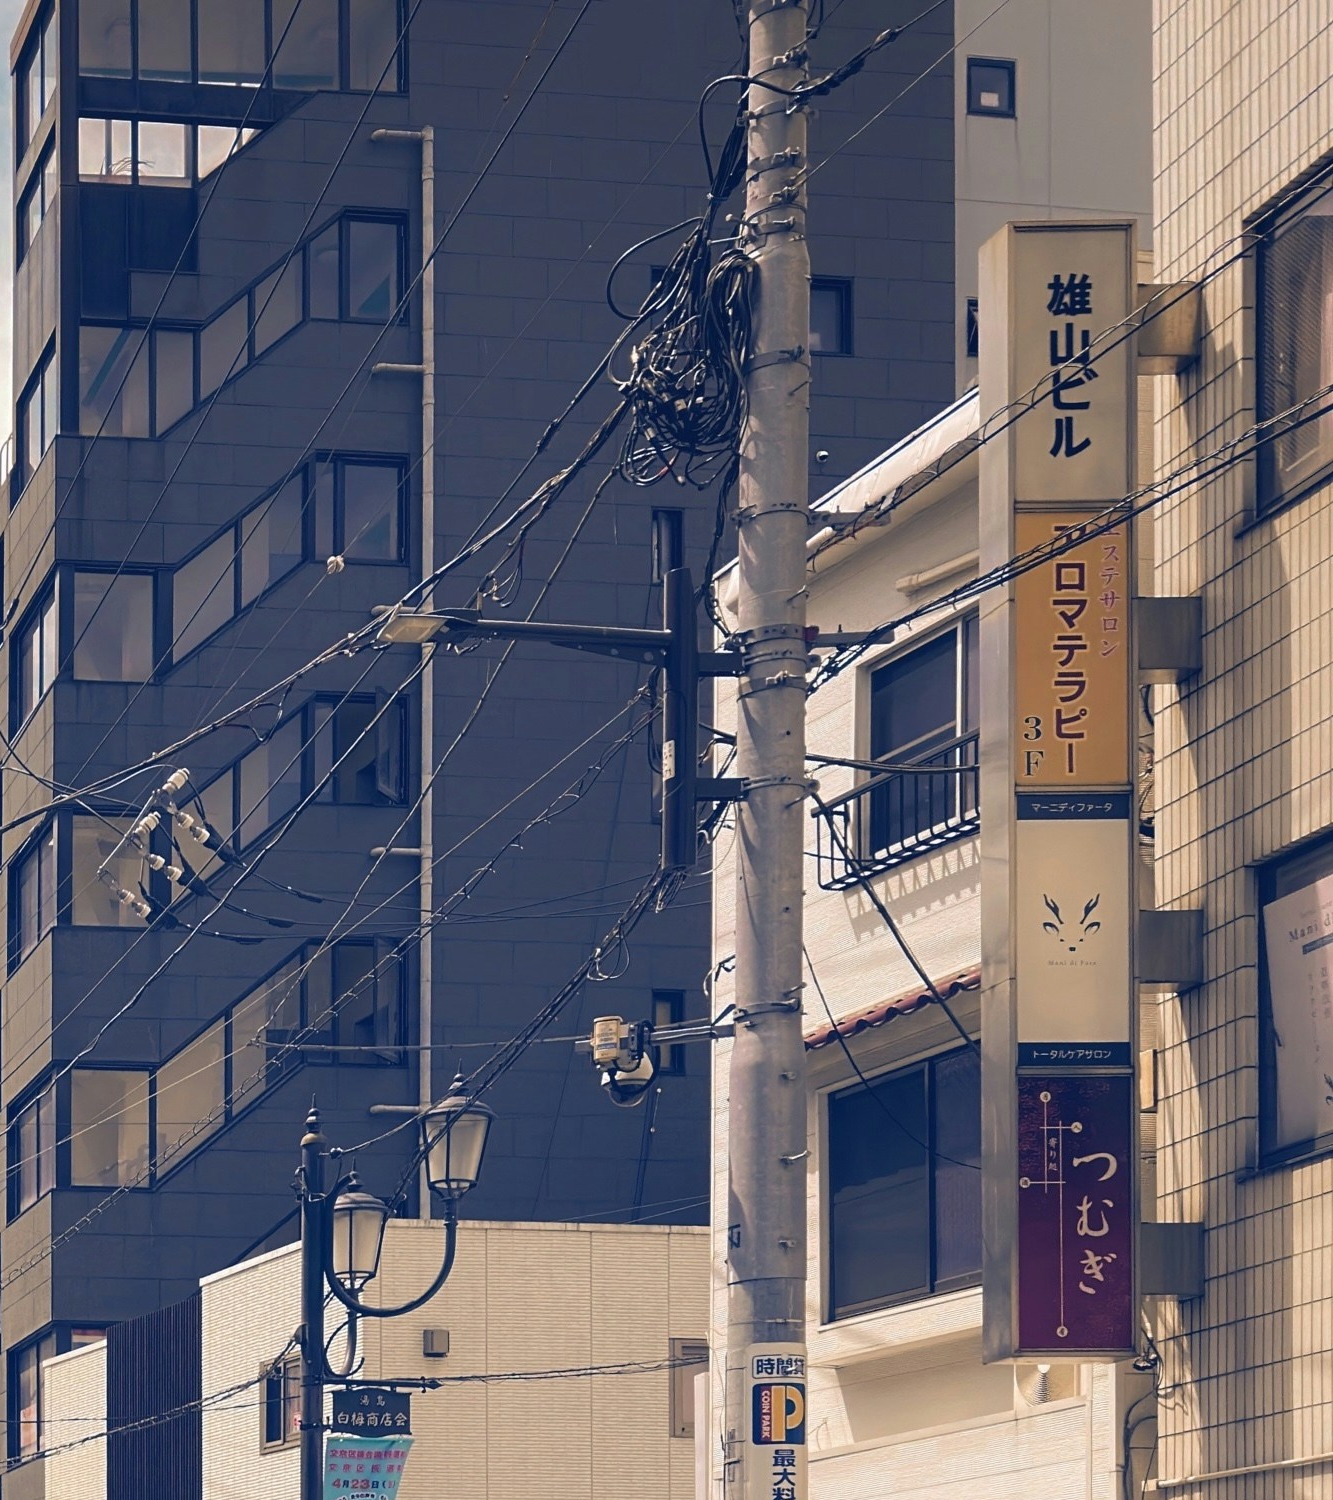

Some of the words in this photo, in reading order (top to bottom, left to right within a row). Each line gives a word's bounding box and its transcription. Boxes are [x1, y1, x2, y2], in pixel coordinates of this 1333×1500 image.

[1046, 273, 1093, 459] 雄山ビル
[1072, 1152, 1118, 1295] つむぎ
[761, 1389, 769, 1413] COIN
[337, 1411, 407, 1427] 白梅商店会
[761, 1416, 769, 1440] PARK
